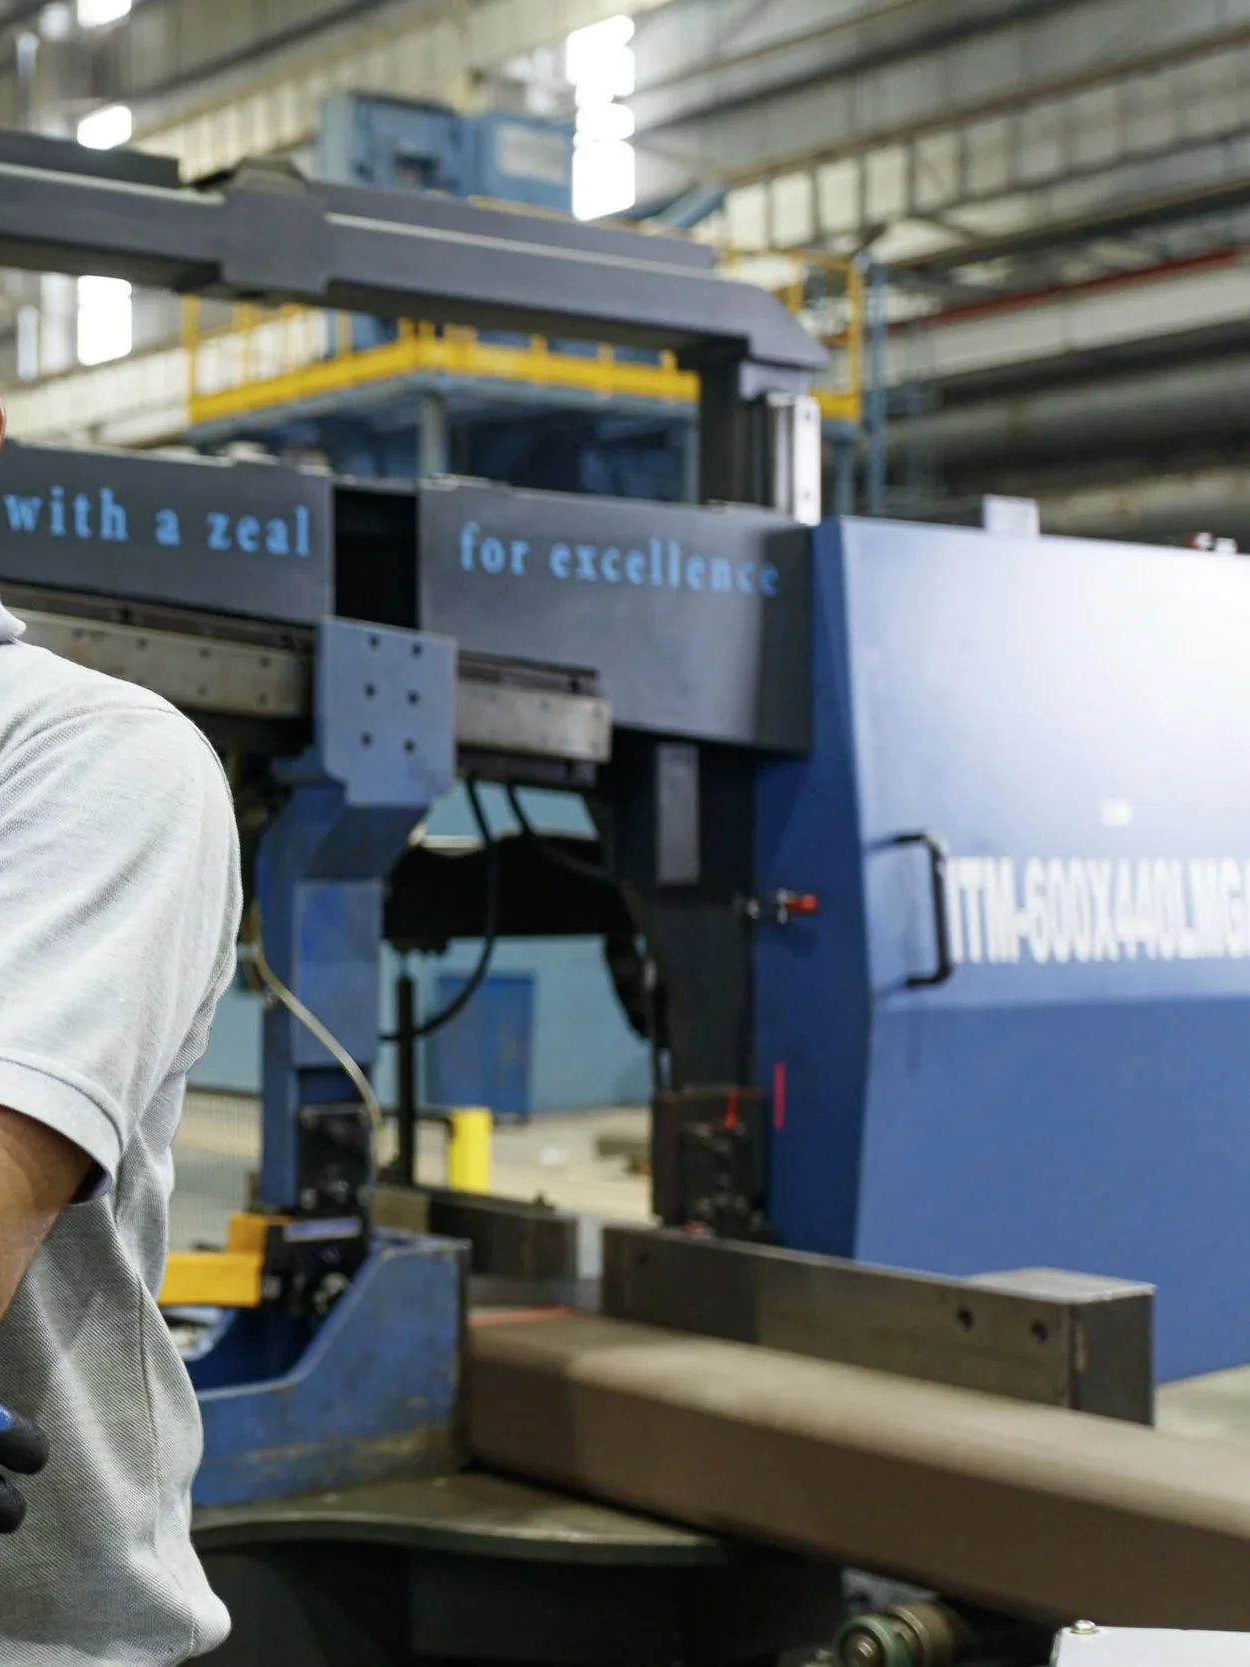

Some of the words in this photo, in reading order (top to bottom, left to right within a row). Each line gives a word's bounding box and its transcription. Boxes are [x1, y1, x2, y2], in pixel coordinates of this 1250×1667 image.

[154, 507, 180, 546] a
[206, 504, 311, 558] zeal
[458, 520, 530, 576] for
[549, 537, 779, 598] excellence
[945, 855, 1250, 965] ITM-600X440LMG
